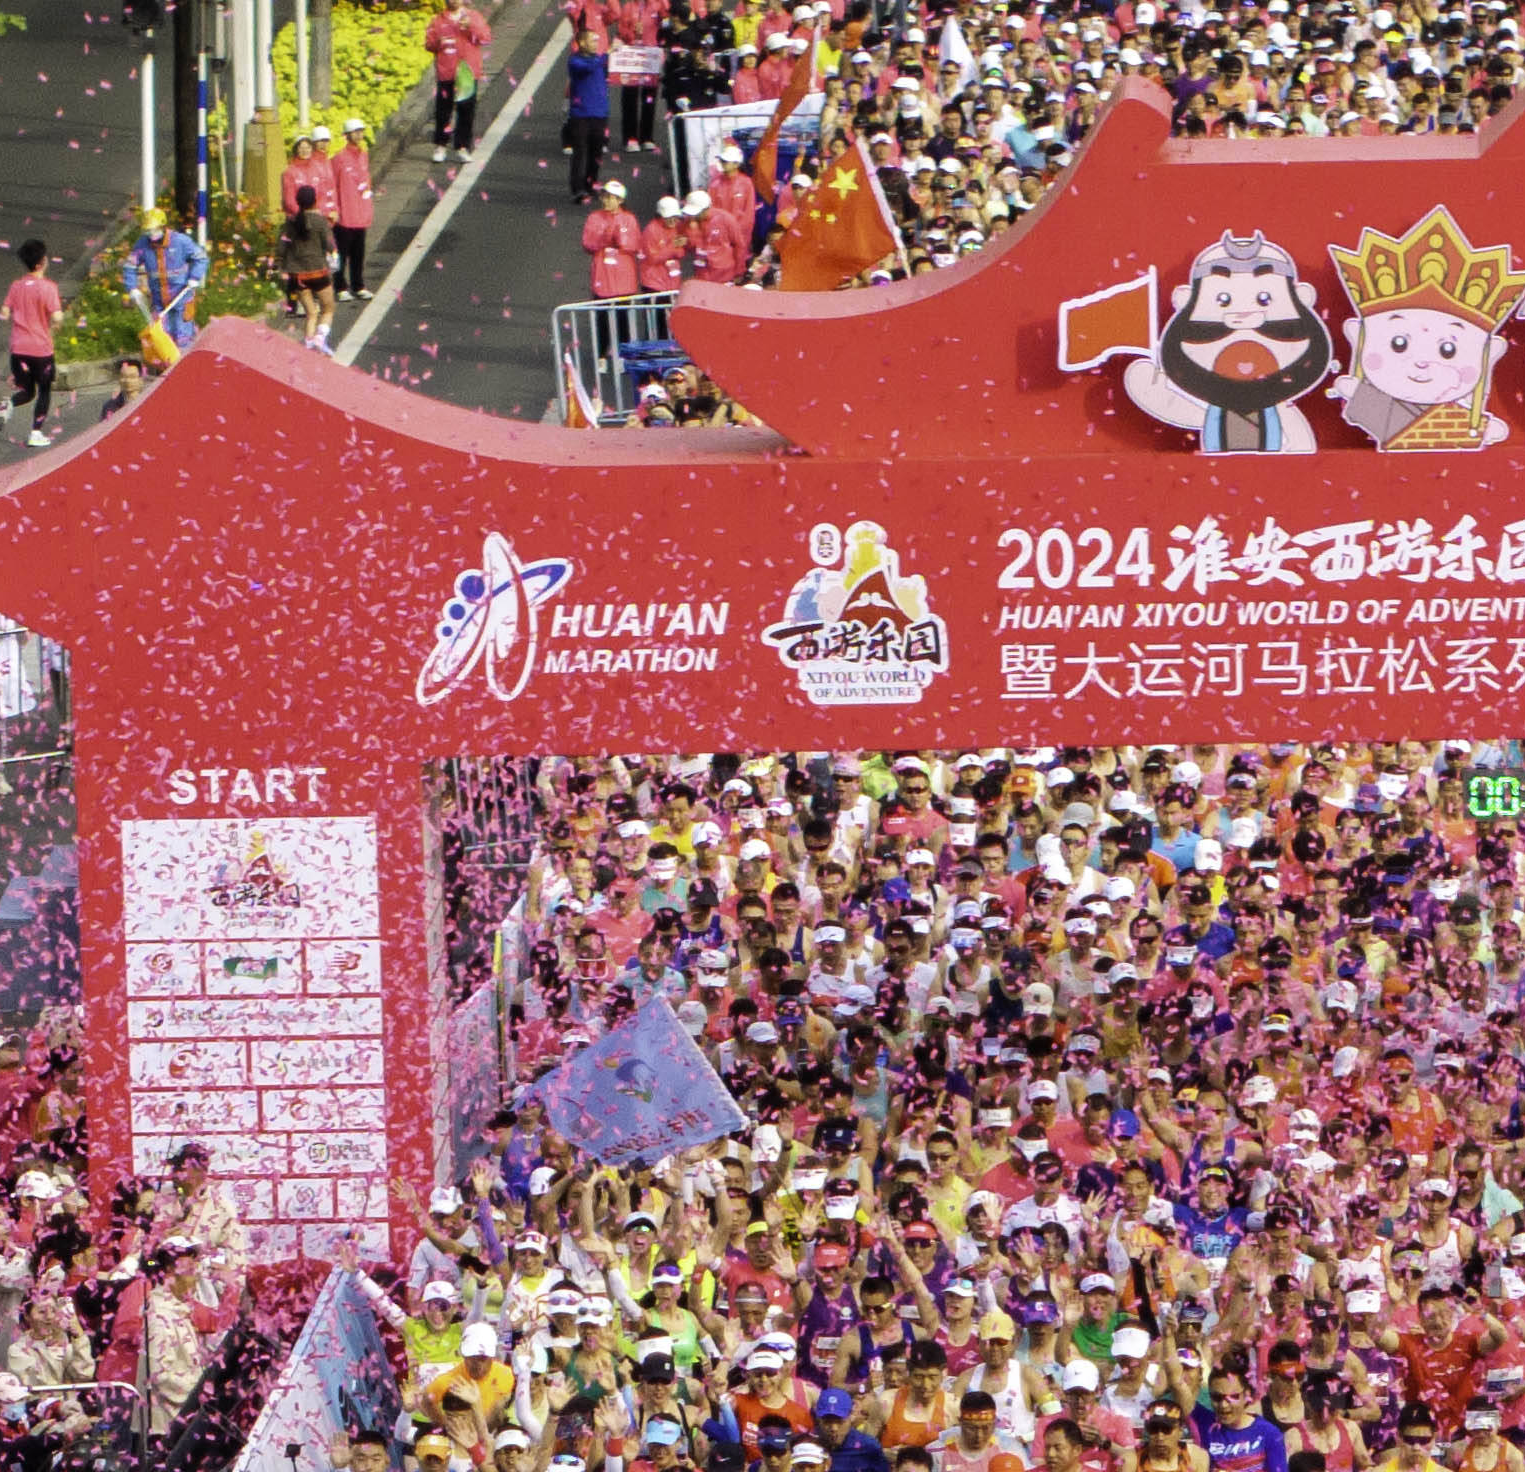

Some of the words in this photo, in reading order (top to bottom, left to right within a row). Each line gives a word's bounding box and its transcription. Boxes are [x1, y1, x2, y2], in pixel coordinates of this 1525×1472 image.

[551, 602, 729, 638] HUAI'AN
[999, 604, 1124, 629] HUAI'AN
[1136, 602, 1227, 628] XIYOU
[1239, 600, 1348, 626] WORLD
[1358, 599, 1402, 625] OF
[542, 647, 718, 673] MARATHON
[169, 767, 327, 805] START
